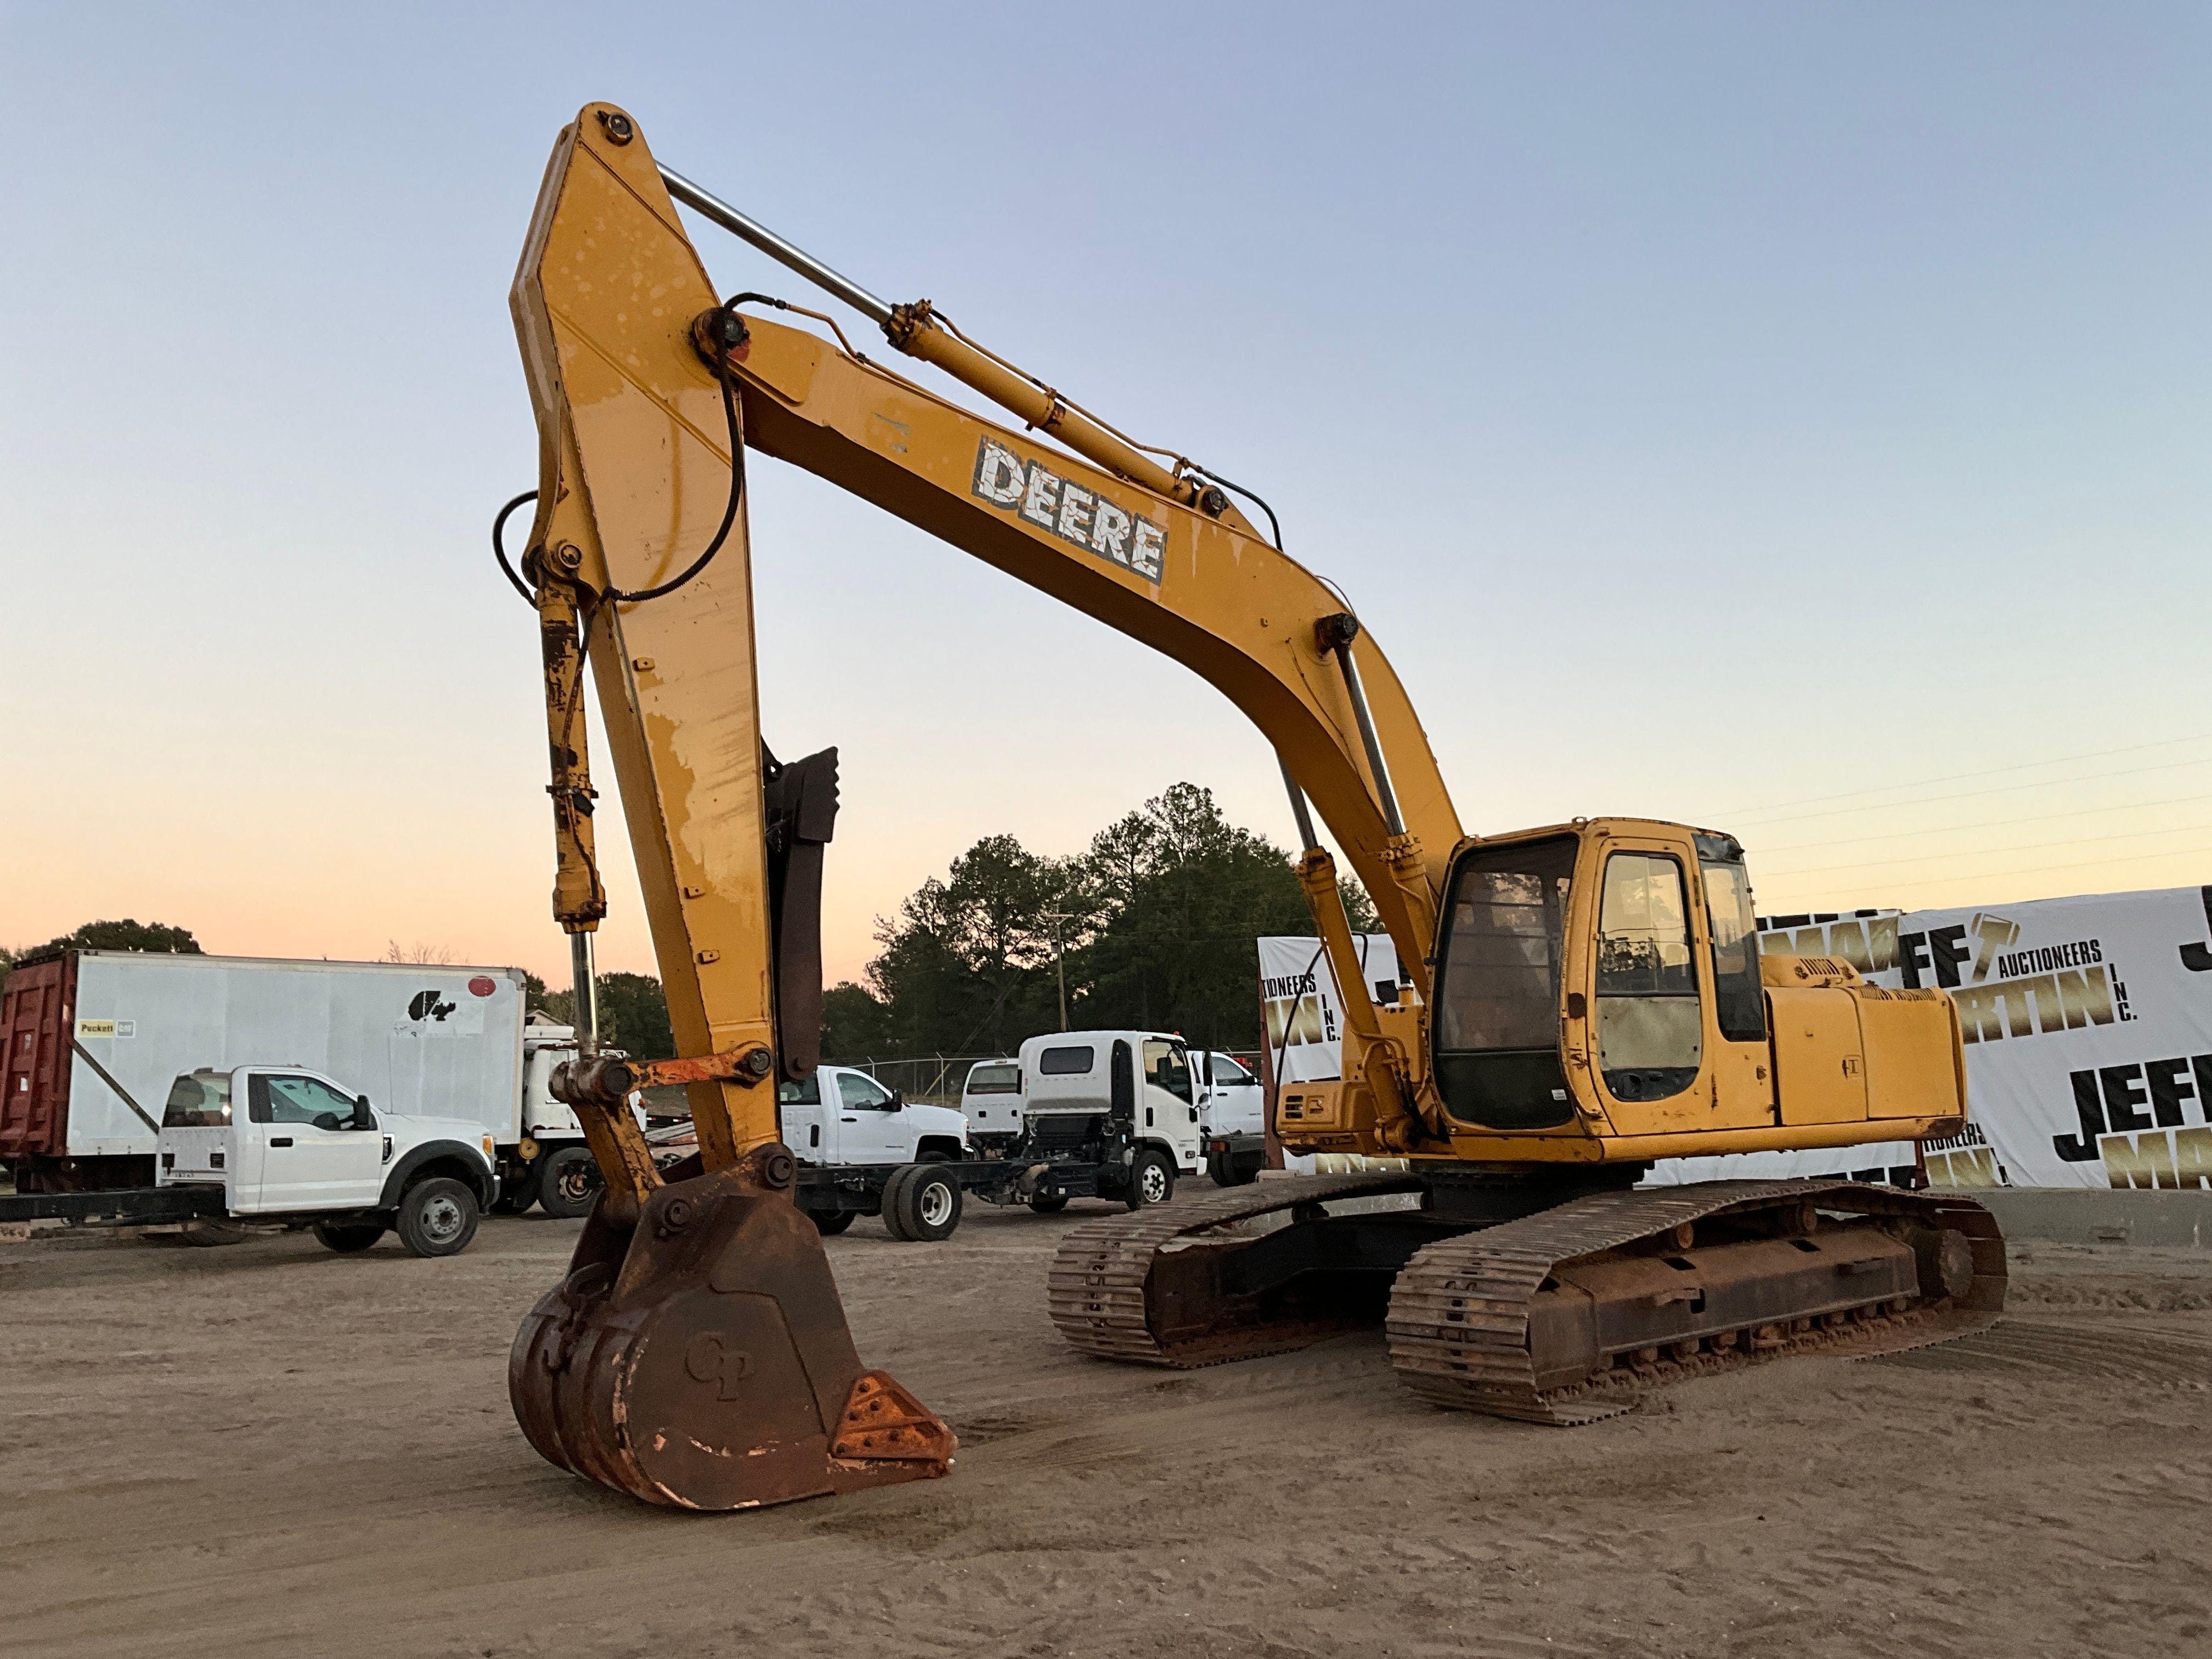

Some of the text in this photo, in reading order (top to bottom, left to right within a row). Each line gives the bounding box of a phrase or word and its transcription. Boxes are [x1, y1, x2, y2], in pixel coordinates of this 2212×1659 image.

[979, 443, 1164, 579] DEERE
[1998, 939, 2102, 978] AUCTIONEERS
[81, 1024, 113, 1032] Puckett
